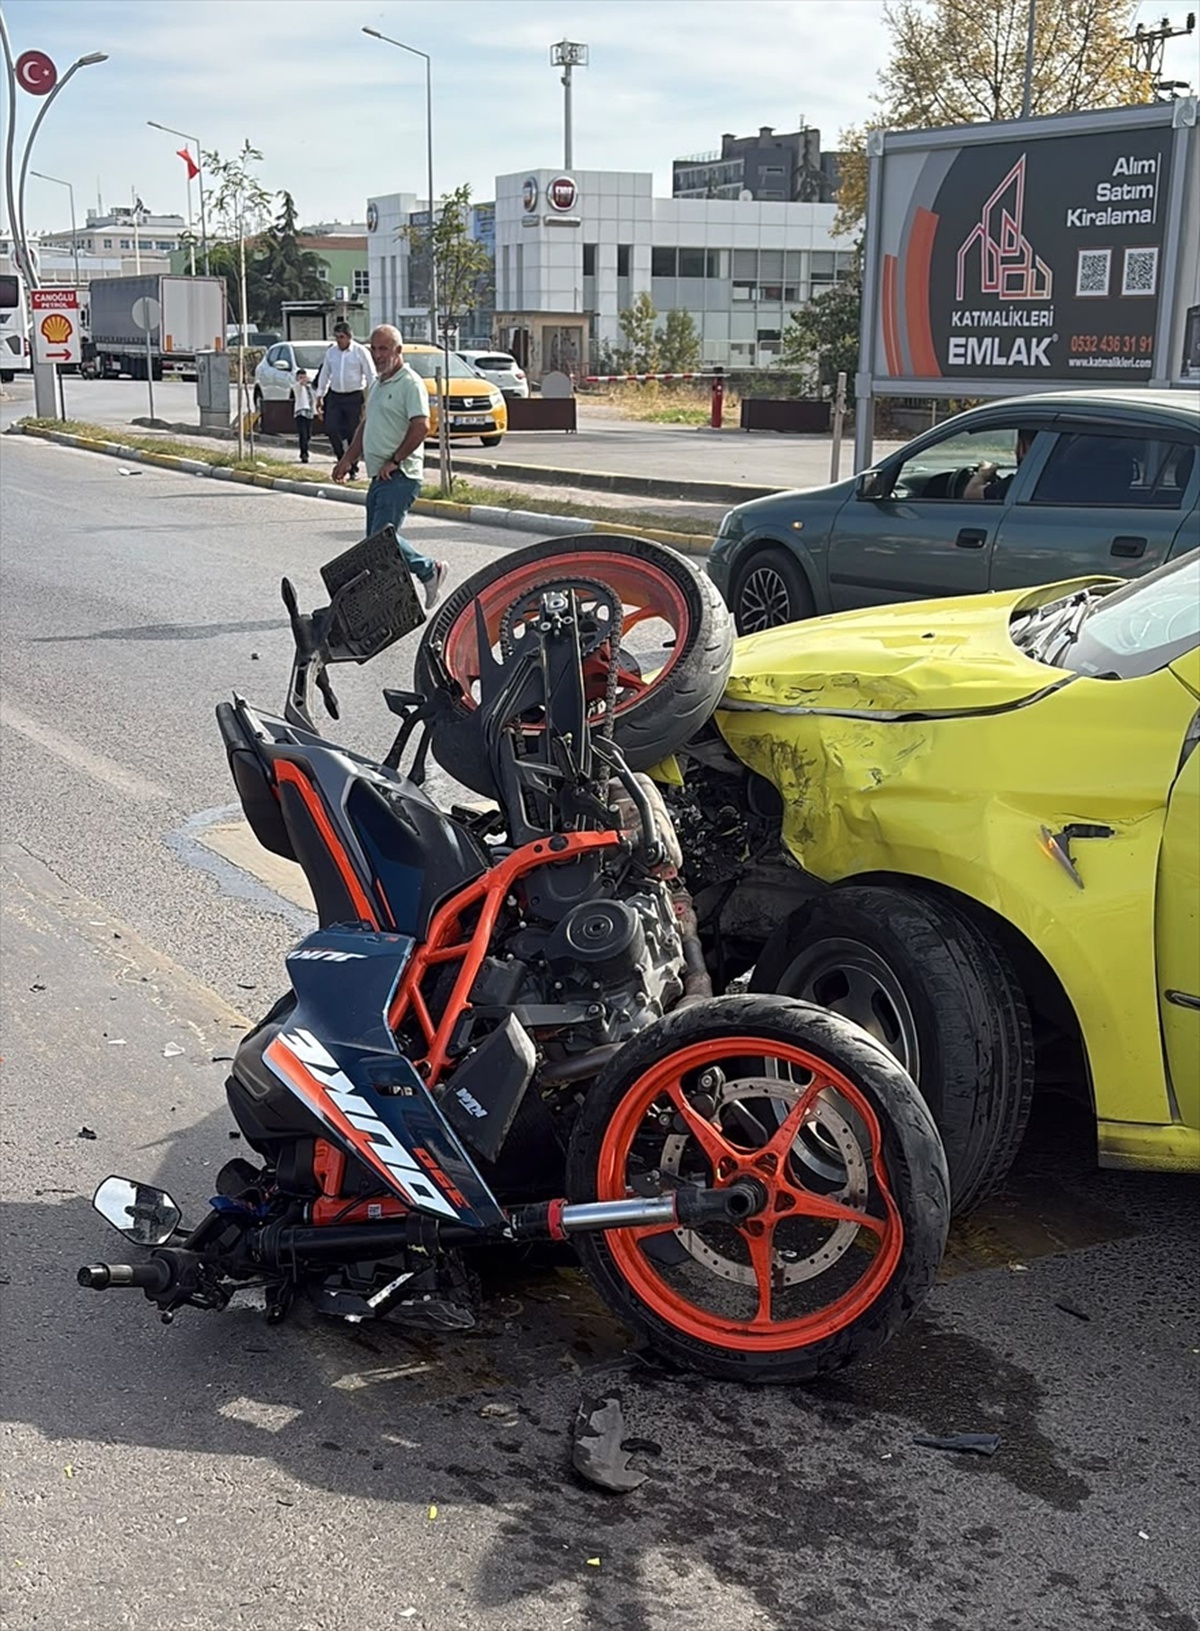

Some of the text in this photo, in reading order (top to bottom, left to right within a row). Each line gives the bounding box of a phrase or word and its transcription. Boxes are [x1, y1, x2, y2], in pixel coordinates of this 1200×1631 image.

[1112, 156, 1156, 176] Alım
[1096, 182, 1154, 202] Satım
[1067, 206, 1152, 227] Kiralama
[952, 305, 1054, 327] KATMALİKLERİ
[948, 336, 1053, 366] EMLAK
[1071, 335, 1152, 352] 0532 436 31 91
[1068, 356, 1152, 368] www.katmalikleri.com
[455, 1087, 488, 1119] KTM
[279, 1028, 461, 1220] DUKE
[413, 1147, 472, 1209] 390
